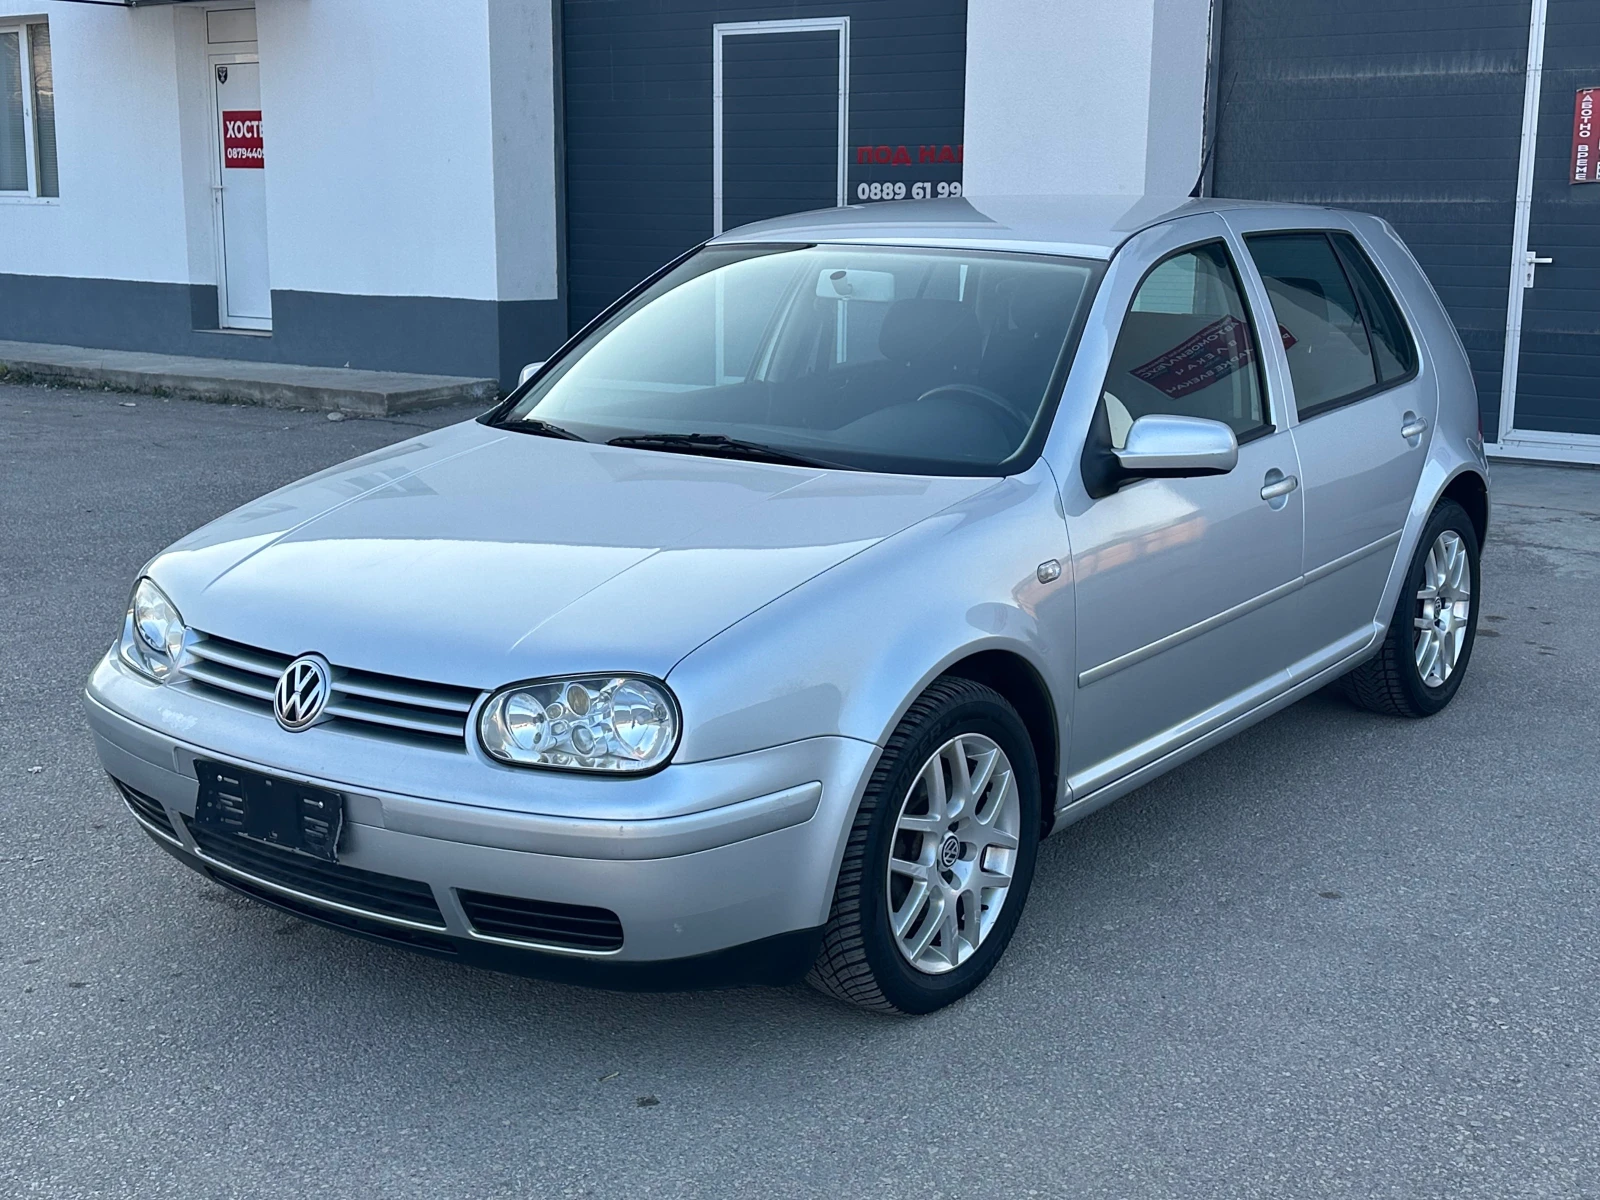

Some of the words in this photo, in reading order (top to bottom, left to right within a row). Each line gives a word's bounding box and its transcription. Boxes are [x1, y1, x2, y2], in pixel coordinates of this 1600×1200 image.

[227, 147, 264, 159] 0879440
[857, 145, 912, 166] ПОД
[1575, 145, 1589, 180] ВРЕМЕ
[857, 182, 906, 200] 0889
[911, 182, 931, 199] 61
[936, 182, 962, 198] 99
